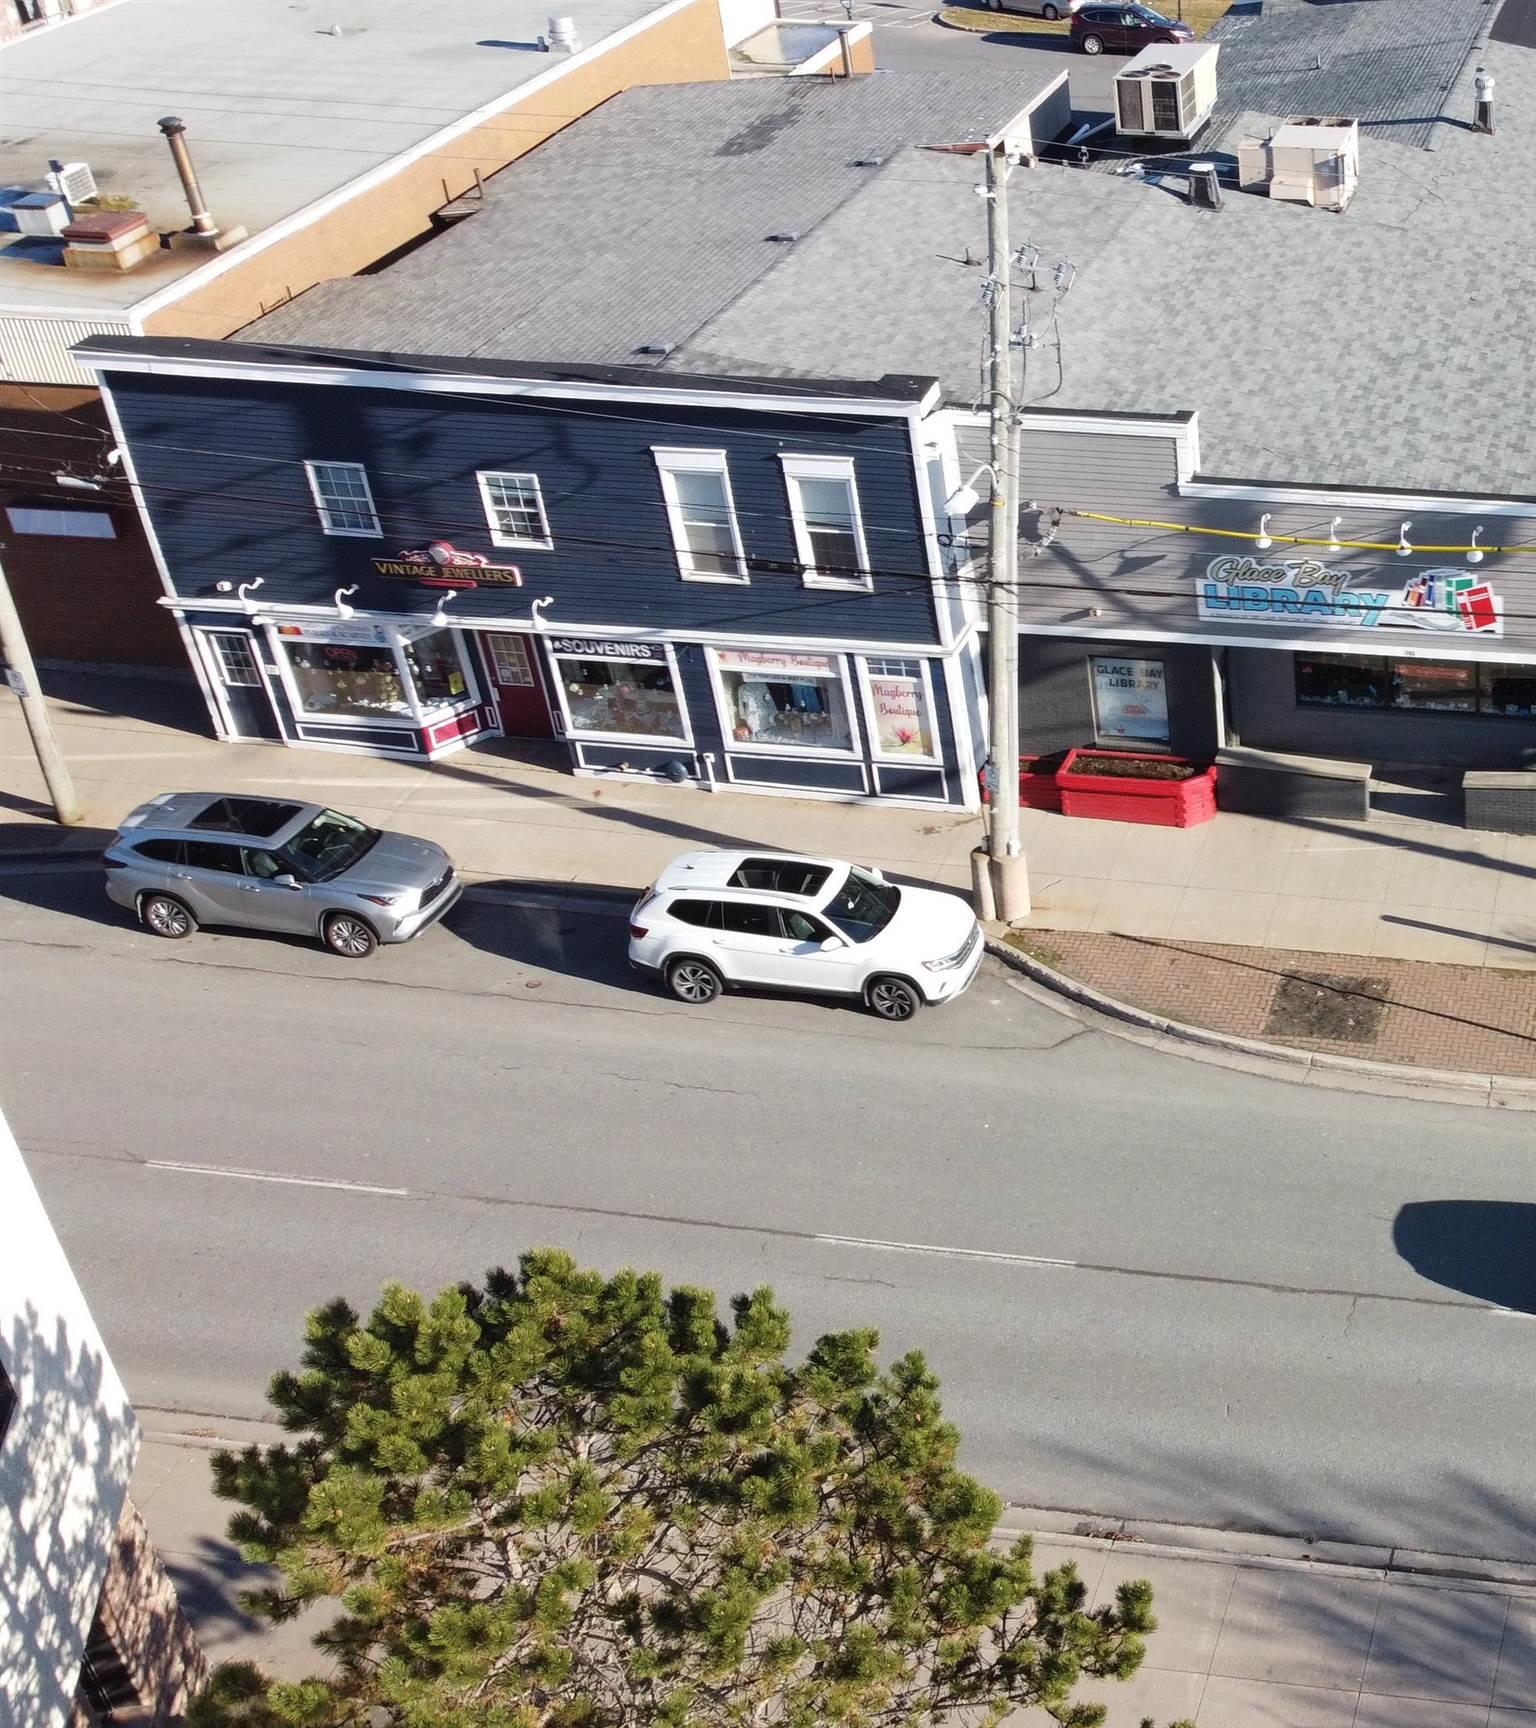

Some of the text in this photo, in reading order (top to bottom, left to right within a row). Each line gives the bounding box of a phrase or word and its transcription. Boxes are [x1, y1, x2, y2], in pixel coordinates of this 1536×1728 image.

[375, 562, 514, 582] VINTAGE JEWELLERS
[1210, 557, 1350, 595] Glace Bay
[1203, 582, 1390, 627] LIBRARY
[561, 639, 652, 657] SOUVENIRS
[1096, 664, 1135, 676] GLACE
[1109, 678, 1160, 690] LIBRARY
